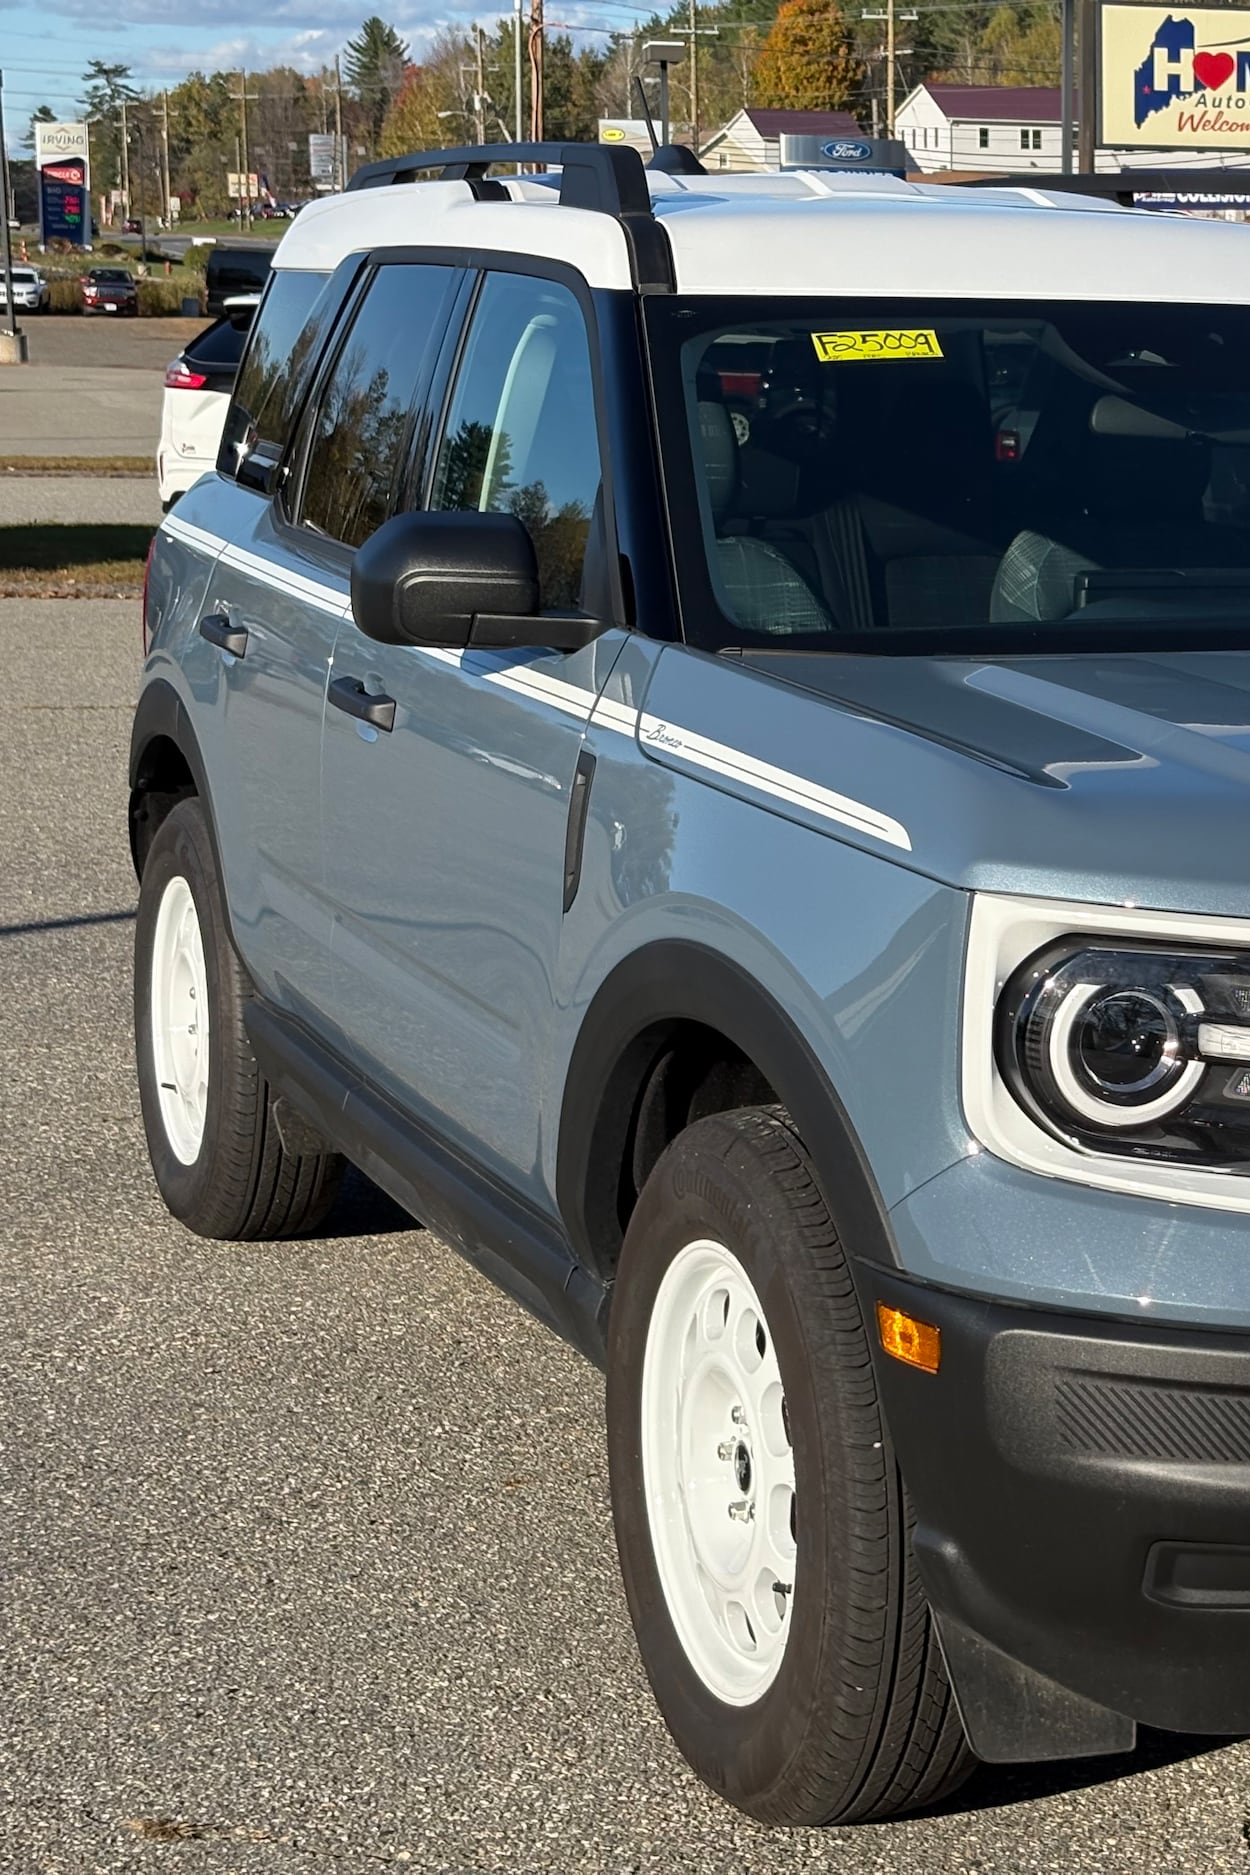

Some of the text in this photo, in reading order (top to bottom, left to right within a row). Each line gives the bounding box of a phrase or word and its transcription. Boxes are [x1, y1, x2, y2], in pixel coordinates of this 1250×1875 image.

[42, 135, 84, 145] IRVING
[829, 142, 866, 158] Ford
[815, 331, 935, 357] F25009
